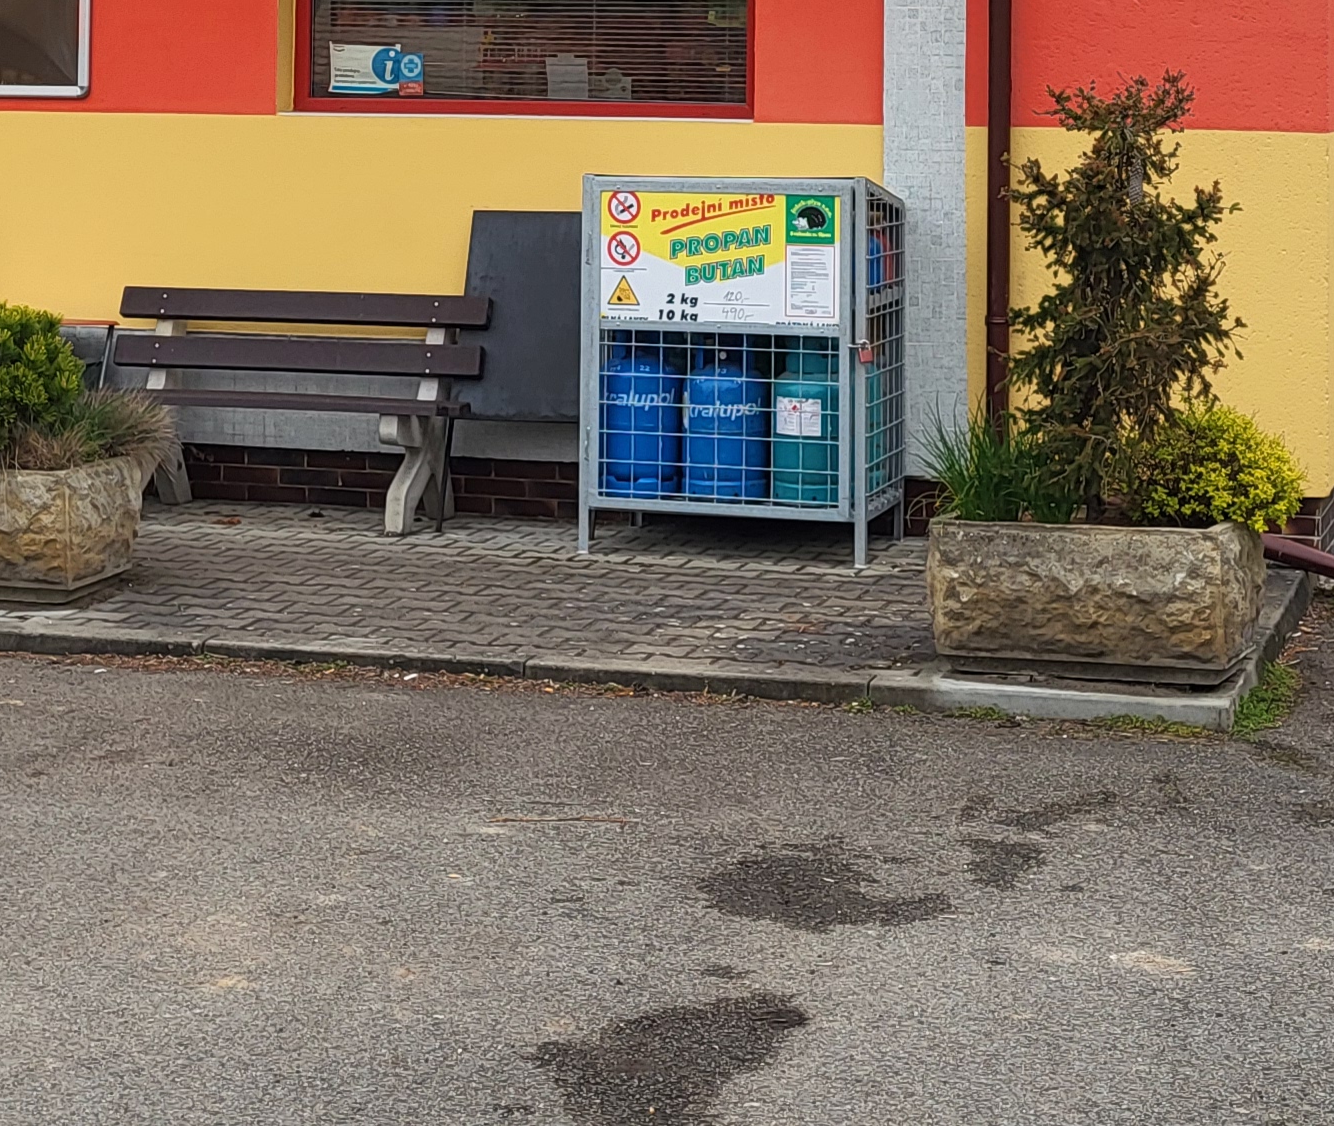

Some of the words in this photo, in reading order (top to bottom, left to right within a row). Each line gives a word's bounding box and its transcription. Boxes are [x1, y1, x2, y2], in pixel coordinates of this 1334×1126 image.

[651, 198, 723, 223] Prodejní
[729, 194, 776, 210] místo
[669, 224, 772, 260] PROPAN
[685, 255, 766, 286] BUTAN
[665, 293, 676, 305] 2
[680, 292, 699, 308] kg
[658, 309, 676, 321] 10
